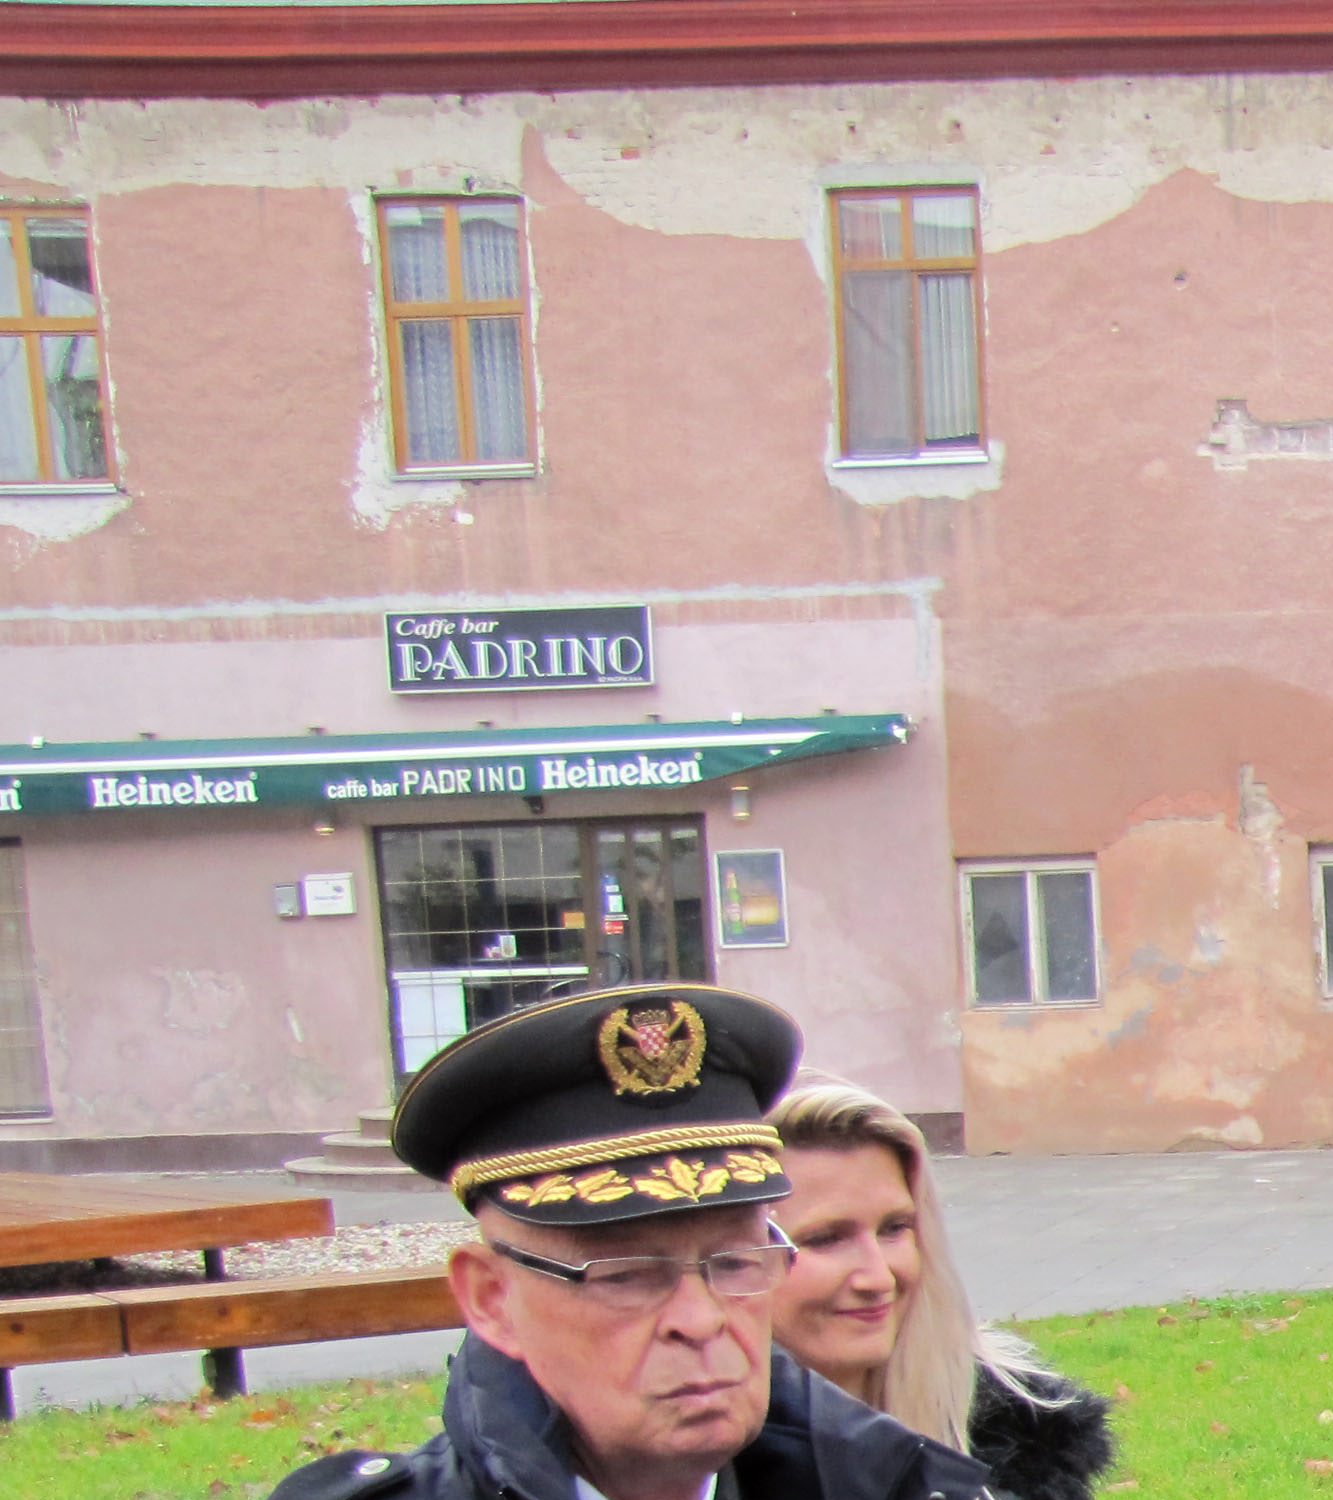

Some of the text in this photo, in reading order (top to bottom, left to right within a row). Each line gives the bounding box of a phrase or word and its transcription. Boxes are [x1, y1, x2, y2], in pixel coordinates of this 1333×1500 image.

[396, 616, 500, 639] Caffe bar
[397, 636, 644, 682] PADRINO
[92, 774, 259, 808] Heineken
[327, 780, 368, 799] caffe
[371, 778, 399, 797] bar
[541, 755, 703, 790] Heineken
